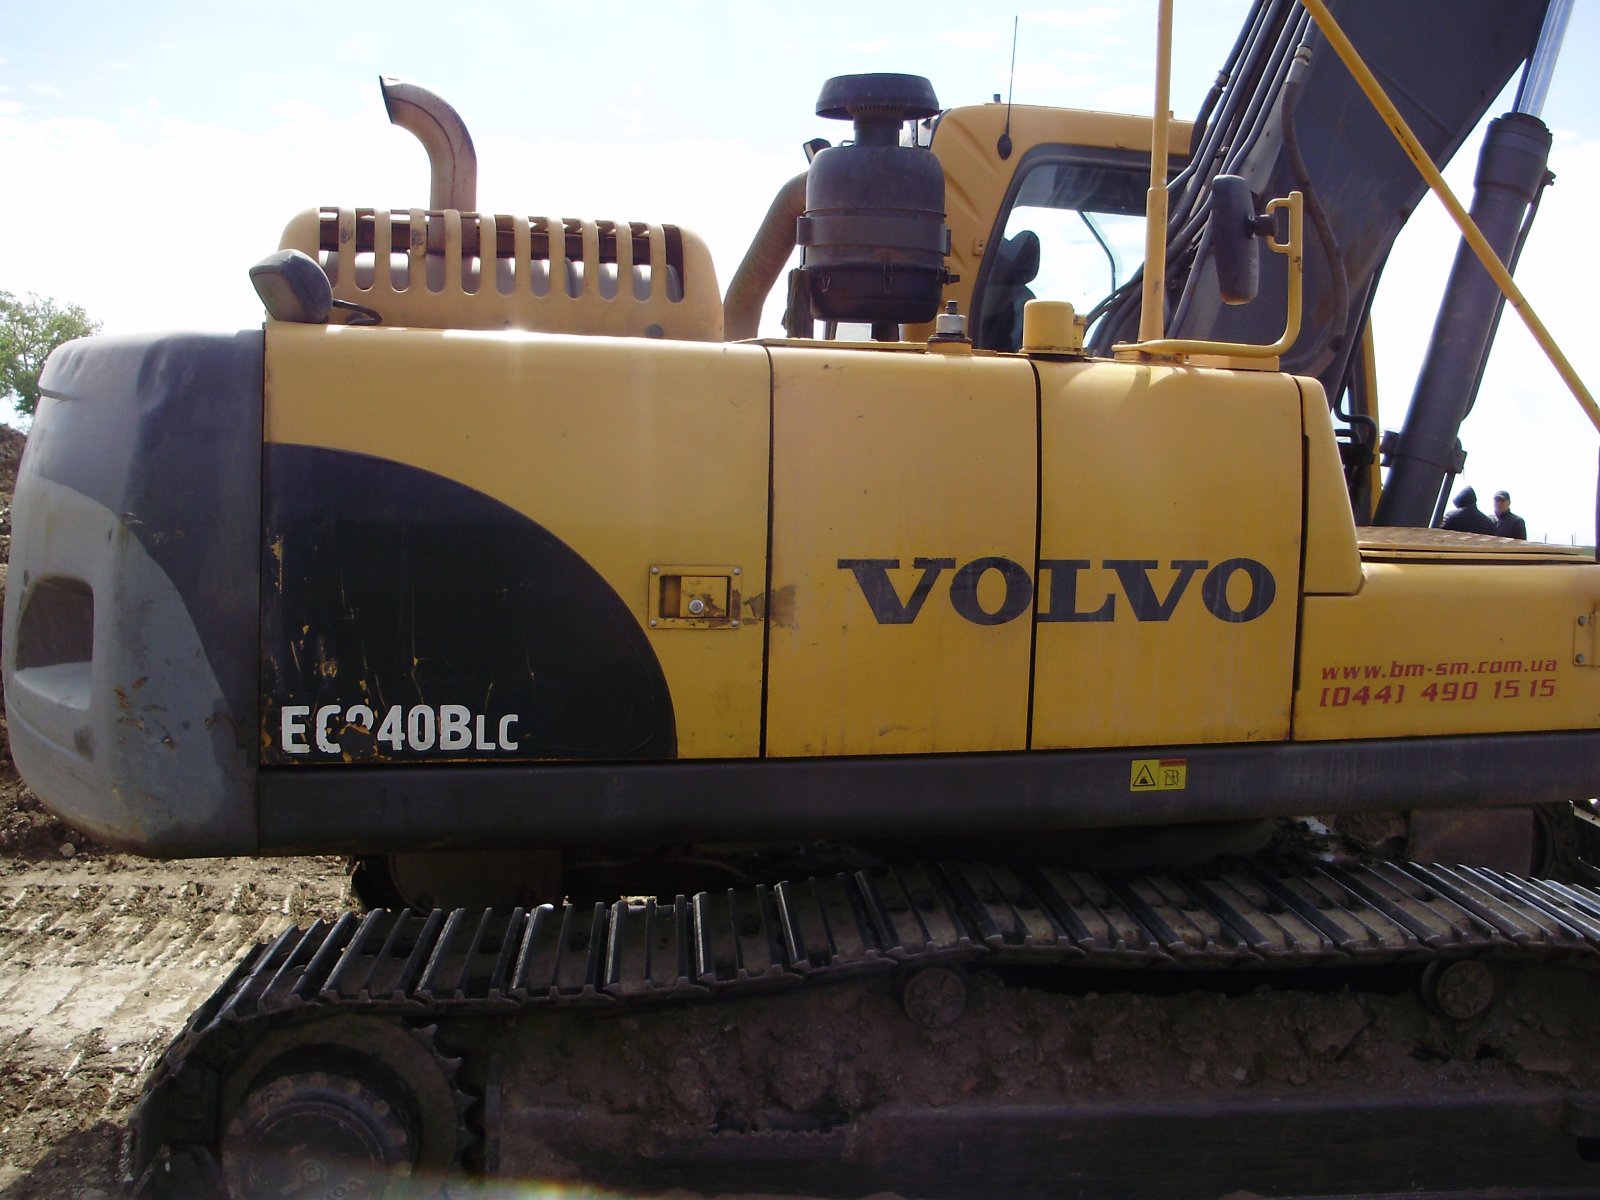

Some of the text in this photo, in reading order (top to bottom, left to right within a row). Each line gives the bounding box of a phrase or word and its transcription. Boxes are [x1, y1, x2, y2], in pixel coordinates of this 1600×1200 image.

[838, 556, 1276, 625] VOLVO
[1321, 659, 1557, 680] www.bm-sm.com.ua
[1420, 680, 1478, 702] 490
